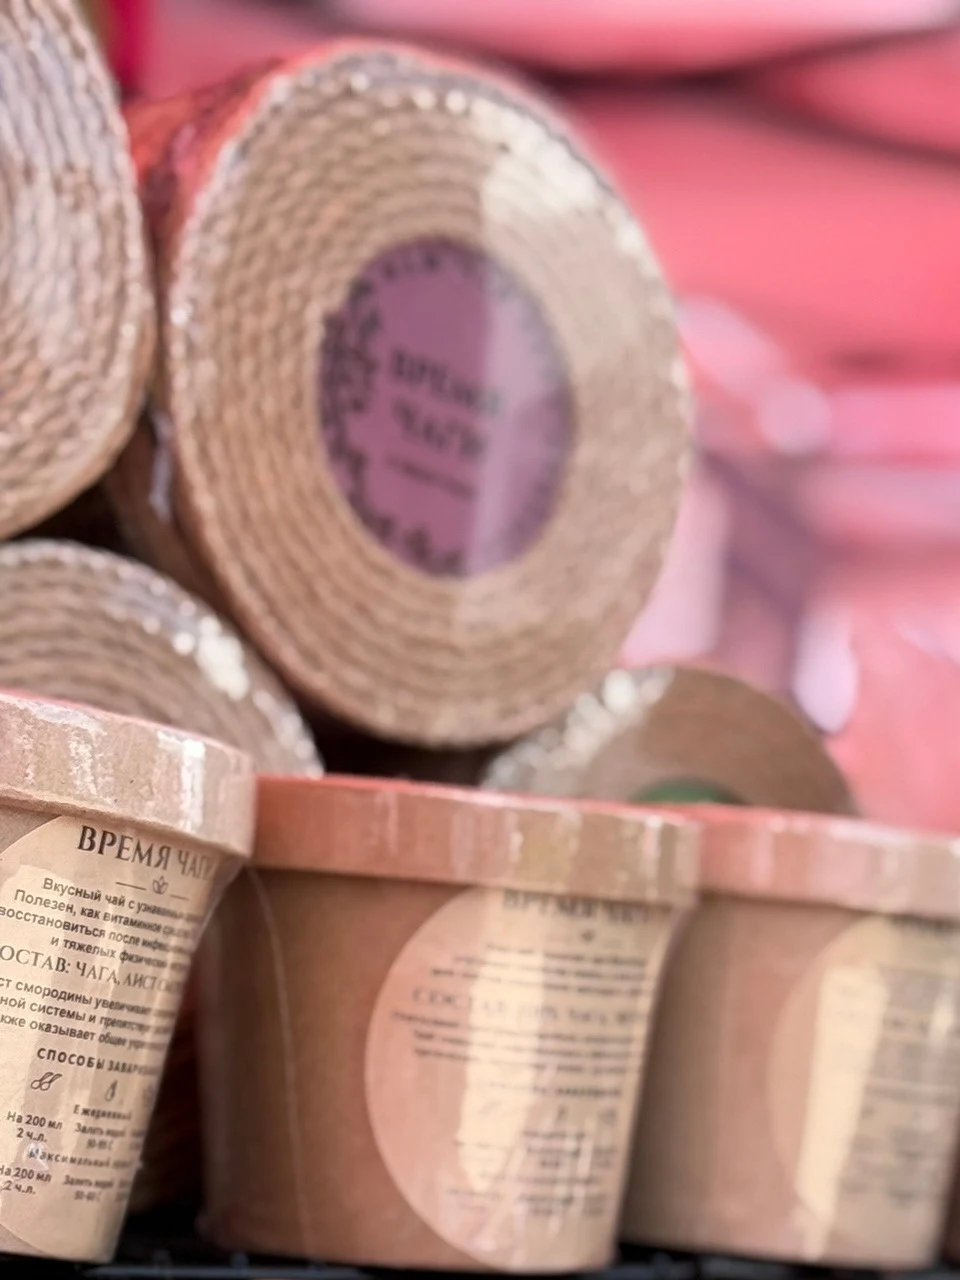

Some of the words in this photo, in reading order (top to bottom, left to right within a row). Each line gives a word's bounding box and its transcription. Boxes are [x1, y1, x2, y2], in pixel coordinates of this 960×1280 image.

[77, 825, 172, 871] ВРЕМЯ
[14, 889, 77, 917] Полезен,
[80, 907, 101, 921] как
[43, 877, 102, 902] Вкусный
[105, 892, 126, 908] чай
[128, 900, 136, 910] с
[51, 936, 60, 947] и
[63, 938, 116, 959] тяжелых
[109, 931, 139, 948] после
[76, 961, 121, 986] ЧАГА,
[15, 981, 93, 1006] смородины
[29, 1002, 87, 1024] системы
[89, 1013, 96, 1024] и
[29, 1019, 97, 1042] оказывает
[36, 1047, 105, 1070] СПОСОБЫ
[7, 1111, 24, 1124] На
[25, 1114, 47, 1128] 200
[48, 1119, 63, 1131] мл
[16, 1128, 24, 1138] 2
[3, 1180, 13, 1192] 2
[14, 1167, 35, 1181] 200
[36, 1172, 53, 1183] мл
